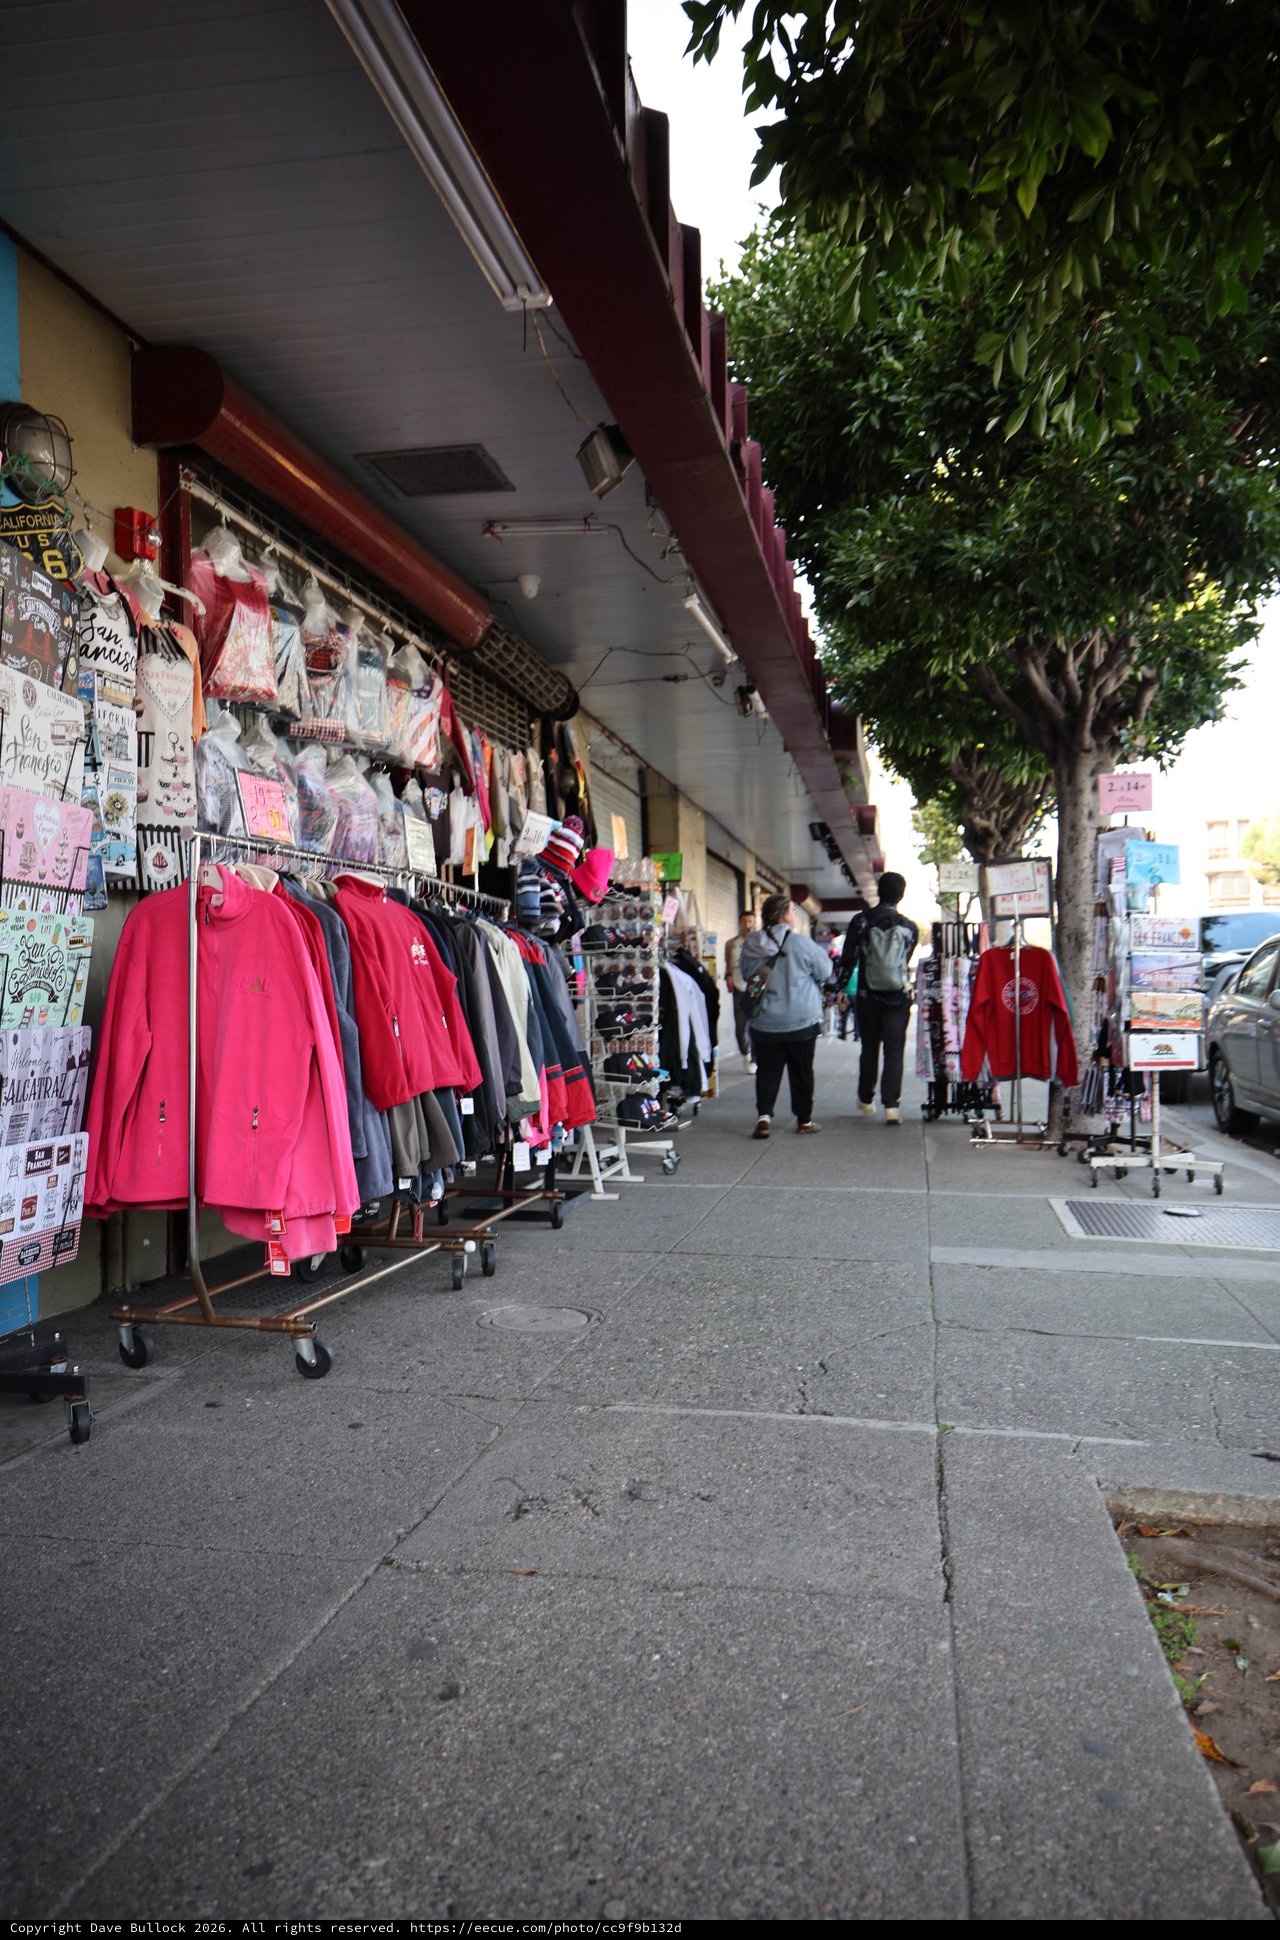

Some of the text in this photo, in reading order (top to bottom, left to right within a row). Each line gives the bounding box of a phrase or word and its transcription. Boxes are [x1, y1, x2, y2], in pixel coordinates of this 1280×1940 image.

[17, 533, 50, 549] U S
[80, 612, 121, 645] San
[79, 643, 136, 673] ancisc
[46, 689, 78, 710] CALIFORNIA
[20, 714, 47, 753] San
[5, 735, 62, 781] Francisco
[3, 1073, 67, 1106] ALCATRAZ
[26, 1158, 51, 1171] FRANCISCO
[35, 1150, 46, 1161] SAN
